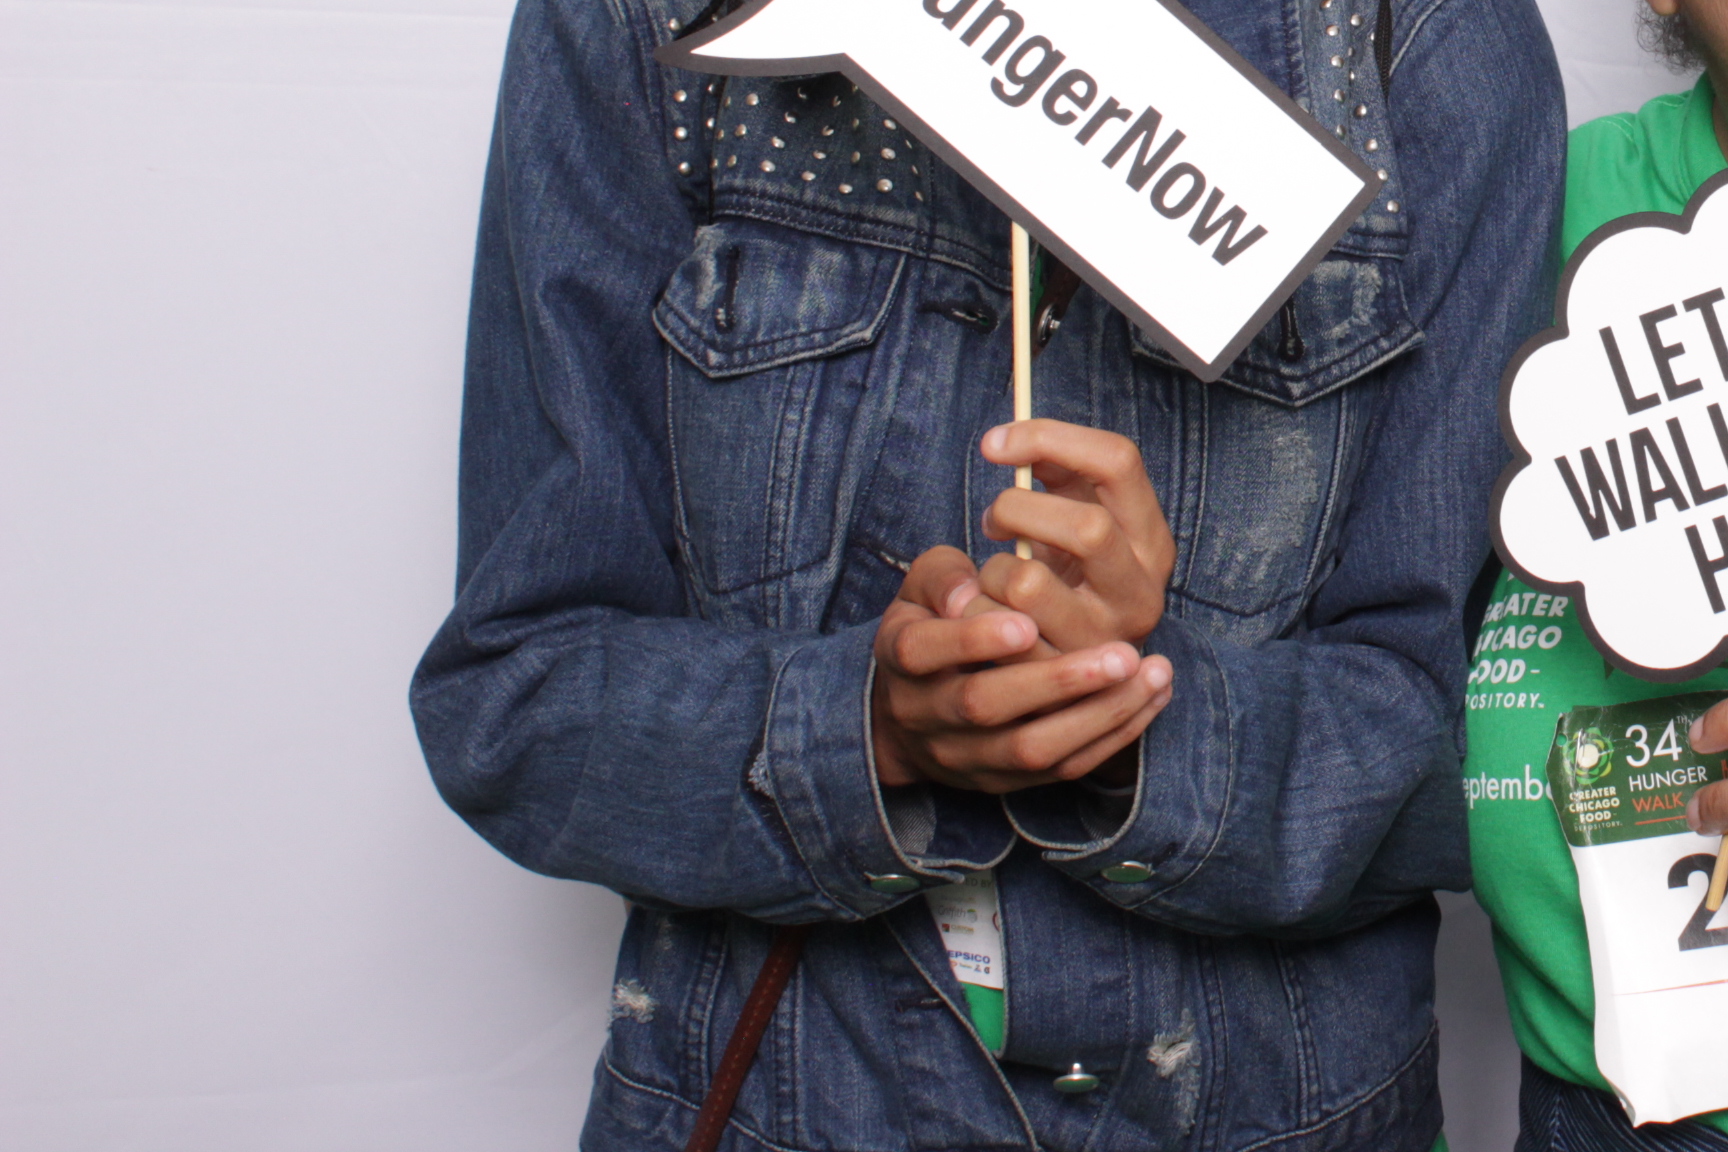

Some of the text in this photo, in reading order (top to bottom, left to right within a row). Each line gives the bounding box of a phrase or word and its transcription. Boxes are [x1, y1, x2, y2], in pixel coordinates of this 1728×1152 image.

[1462, 763, 1554, 810] eptemb
[1628, 766, 1708, 793] HUNGER
[1569, 785, 1617, 802] GREATER
[1631, 791, 1686, 813] WALK
[1568, 797, 1621, 814] CHICAGO
[1579, 810, 1612, 824] FOOD
